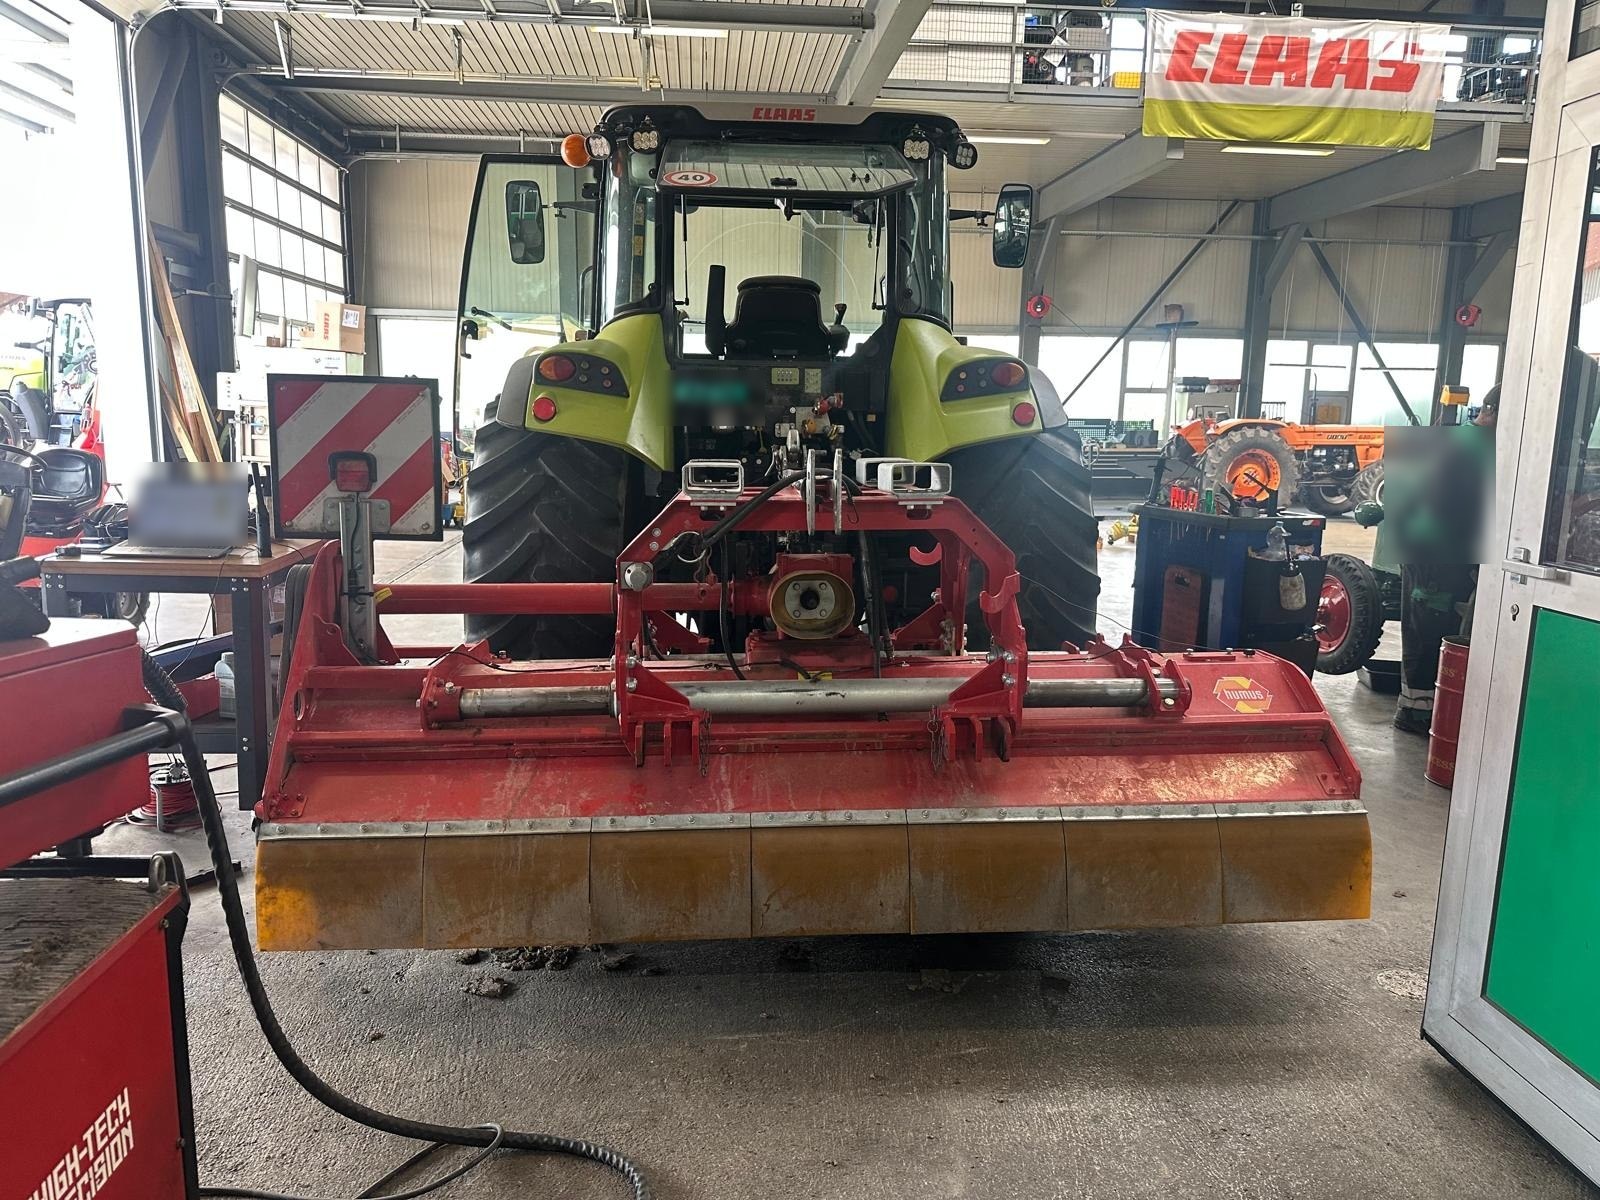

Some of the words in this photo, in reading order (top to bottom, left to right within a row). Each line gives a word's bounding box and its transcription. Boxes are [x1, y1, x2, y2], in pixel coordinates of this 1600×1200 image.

[1165, 31, 1424, 92] CLAAS
[752, 107, 816, 121] CLAAS
[1223, 689, 1264, 700] humus
